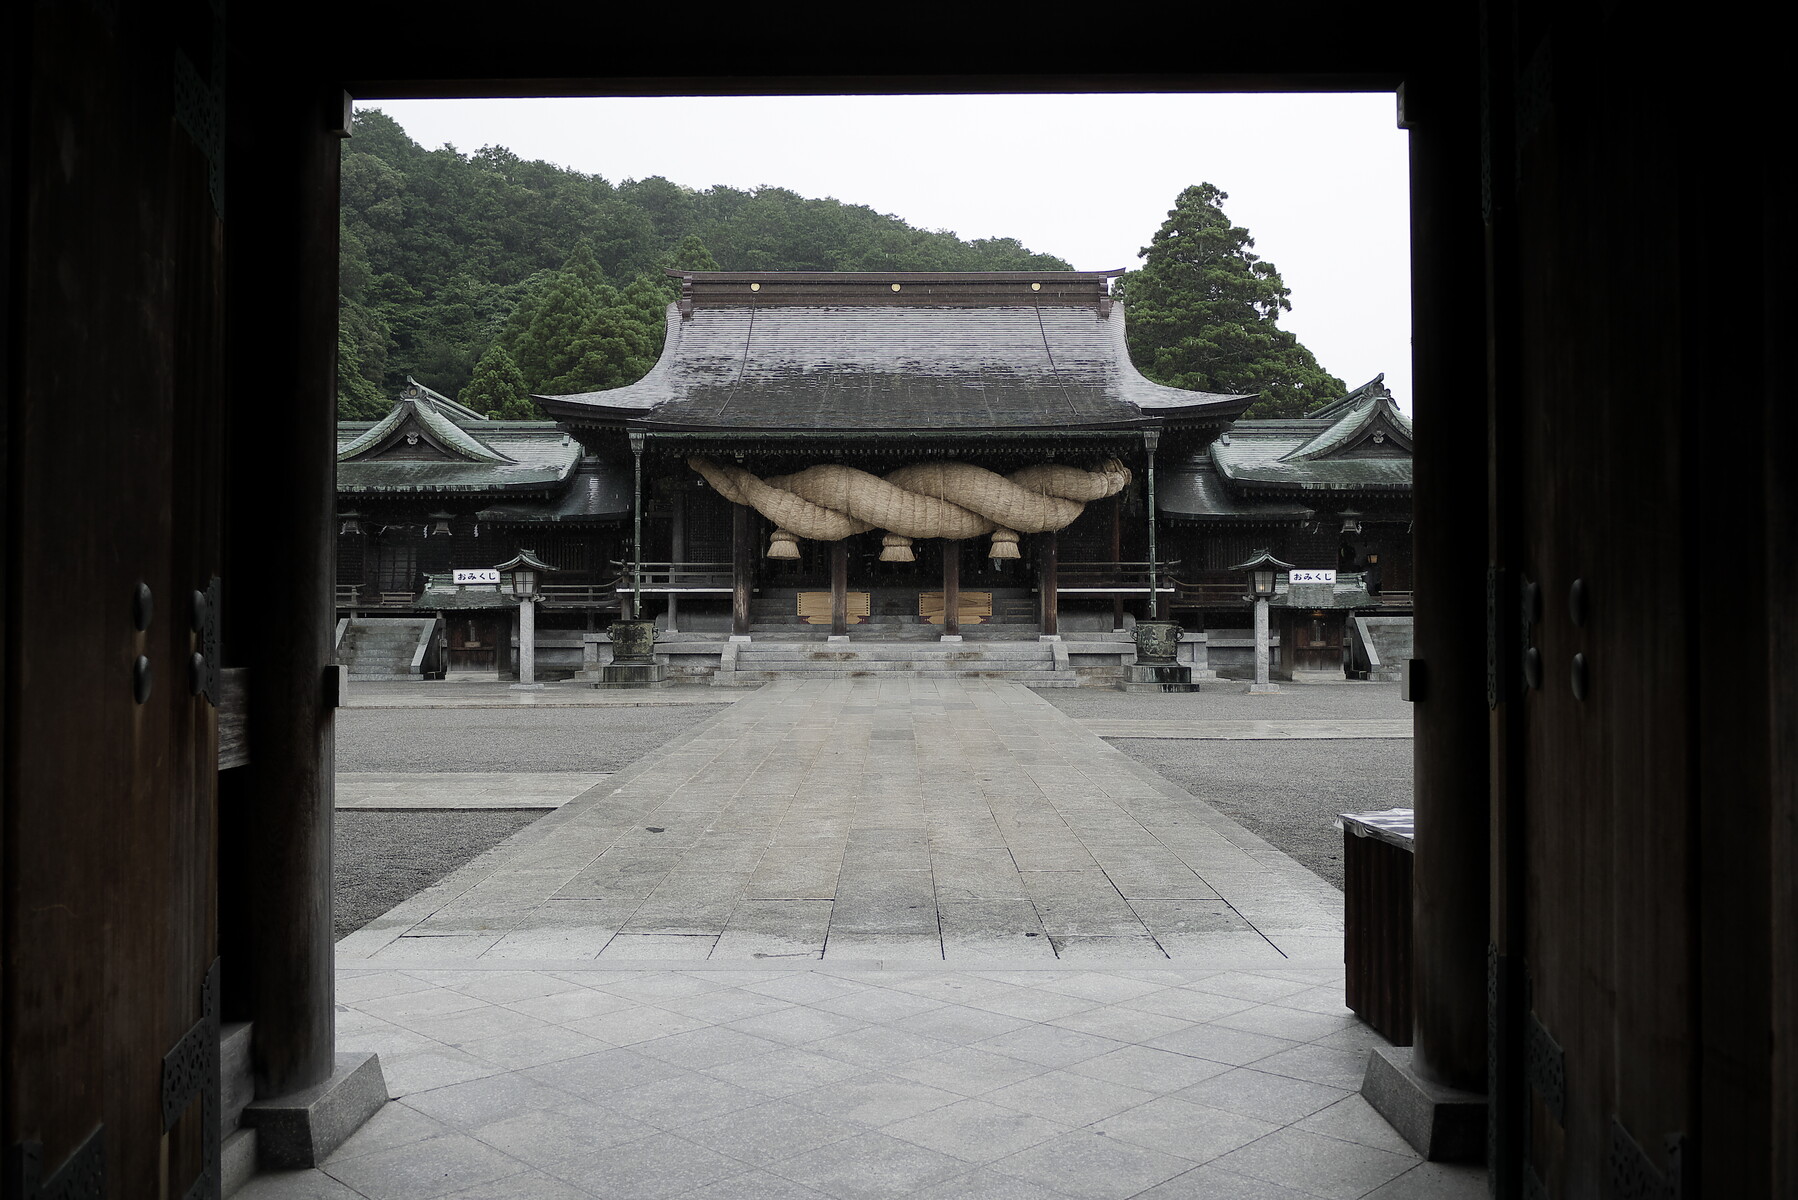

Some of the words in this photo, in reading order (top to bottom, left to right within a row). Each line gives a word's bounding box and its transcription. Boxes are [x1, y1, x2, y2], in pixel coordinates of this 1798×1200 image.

[457, 572, 497, 581] おみくじ
[1293, 572, 1333, 581] おみくじ
